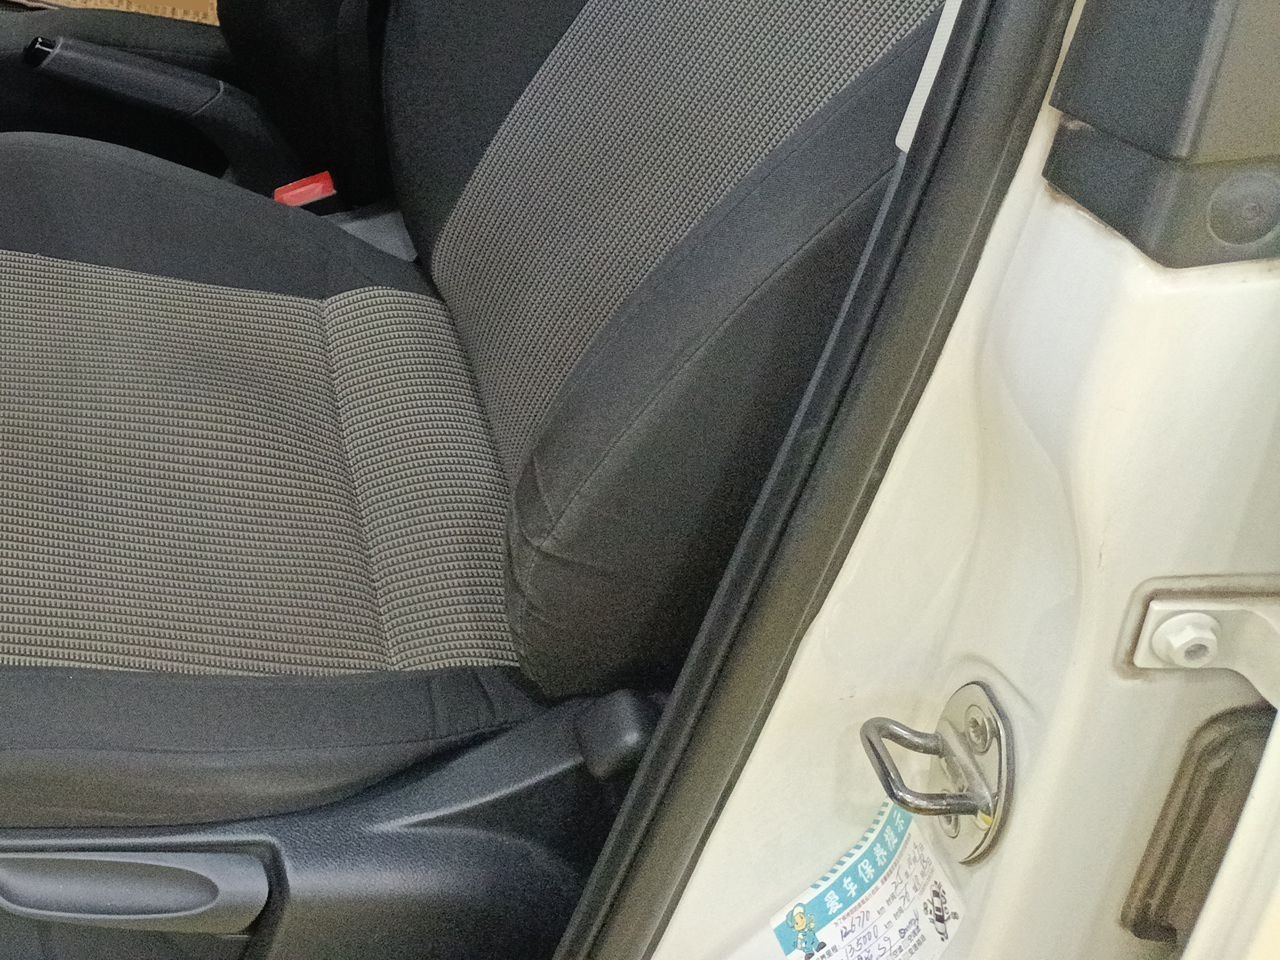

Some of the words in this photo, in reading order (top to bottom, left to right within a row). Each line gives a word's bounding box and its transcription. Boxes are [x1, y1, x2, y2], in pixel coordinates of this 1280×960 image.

[822, 809, 906, 916] 爱车保养提示
